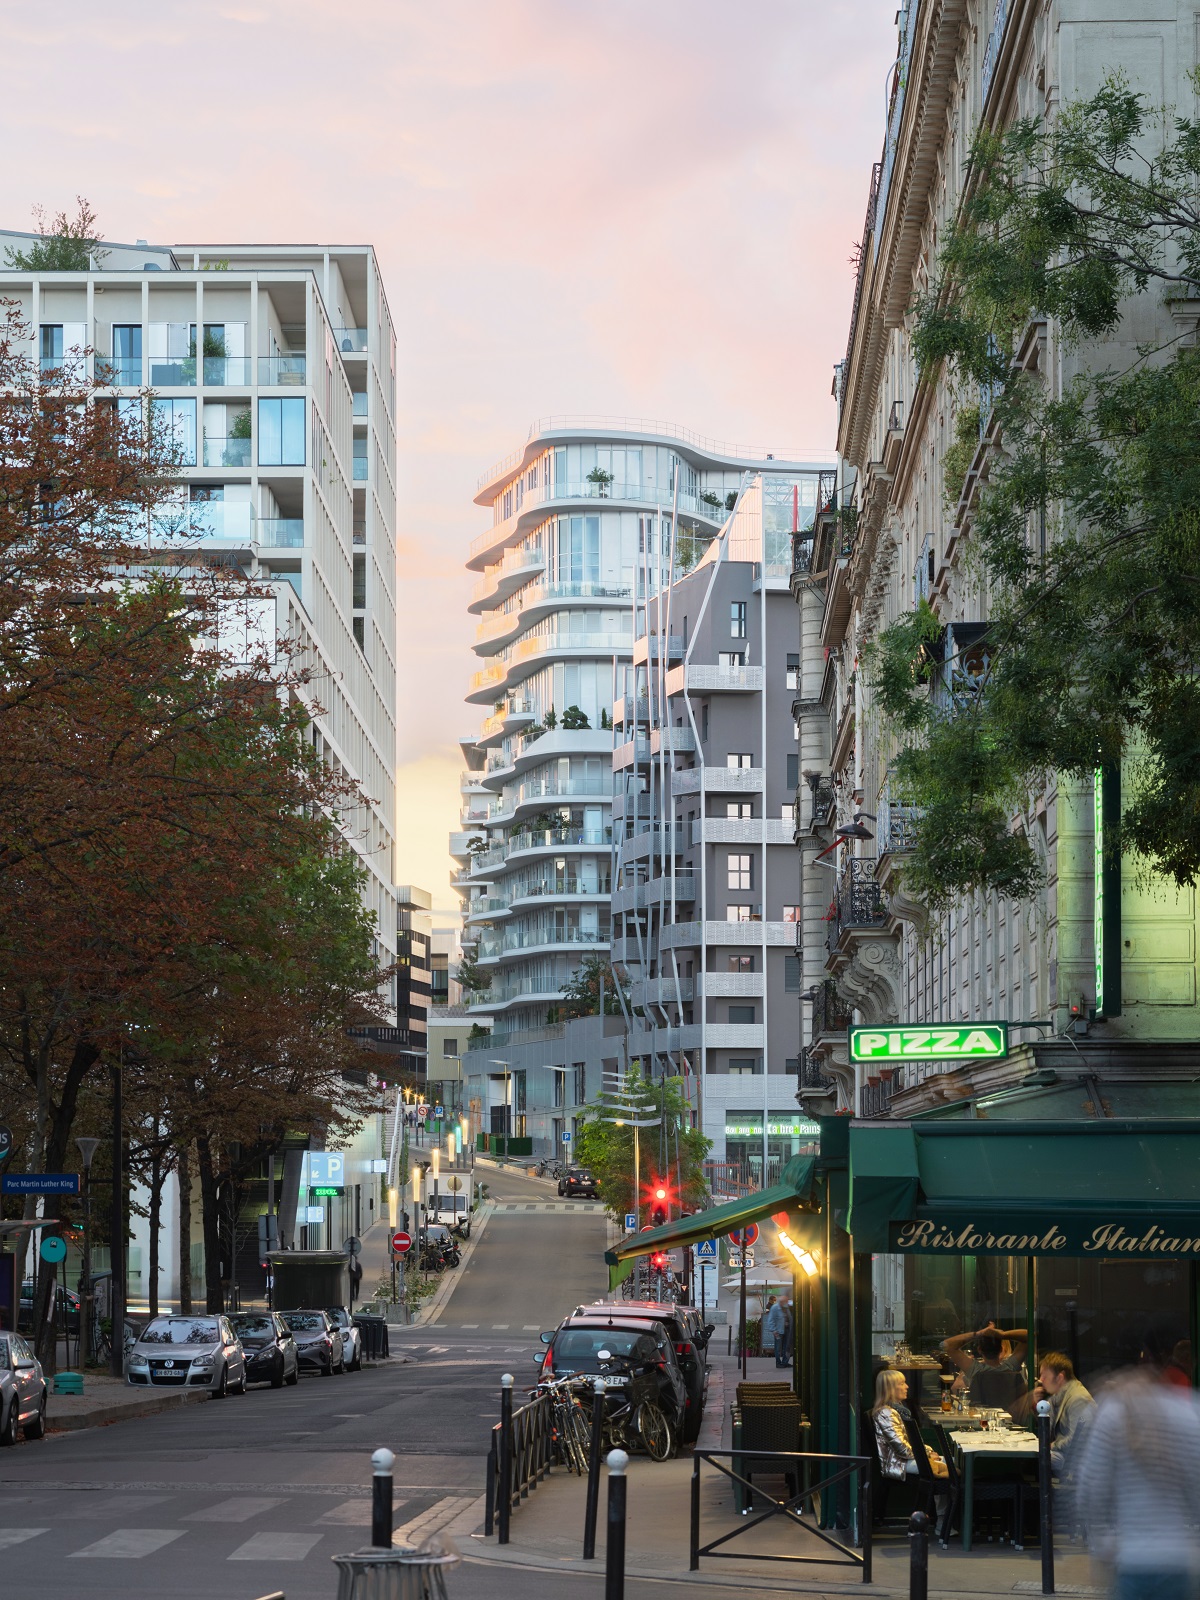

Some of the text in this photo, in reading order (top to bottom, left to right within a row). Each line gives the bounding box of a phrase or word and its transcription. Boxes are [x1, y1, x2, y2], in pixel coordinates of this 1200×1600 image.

[859, 1031, 999, 1055] PIZZA
[328, 1159, 341, 1178] P
[60, 1181, 74, 1189] King
[629, 1217, 635, 1226] P
[897, 1219, 1067, 1250] Ristorante
